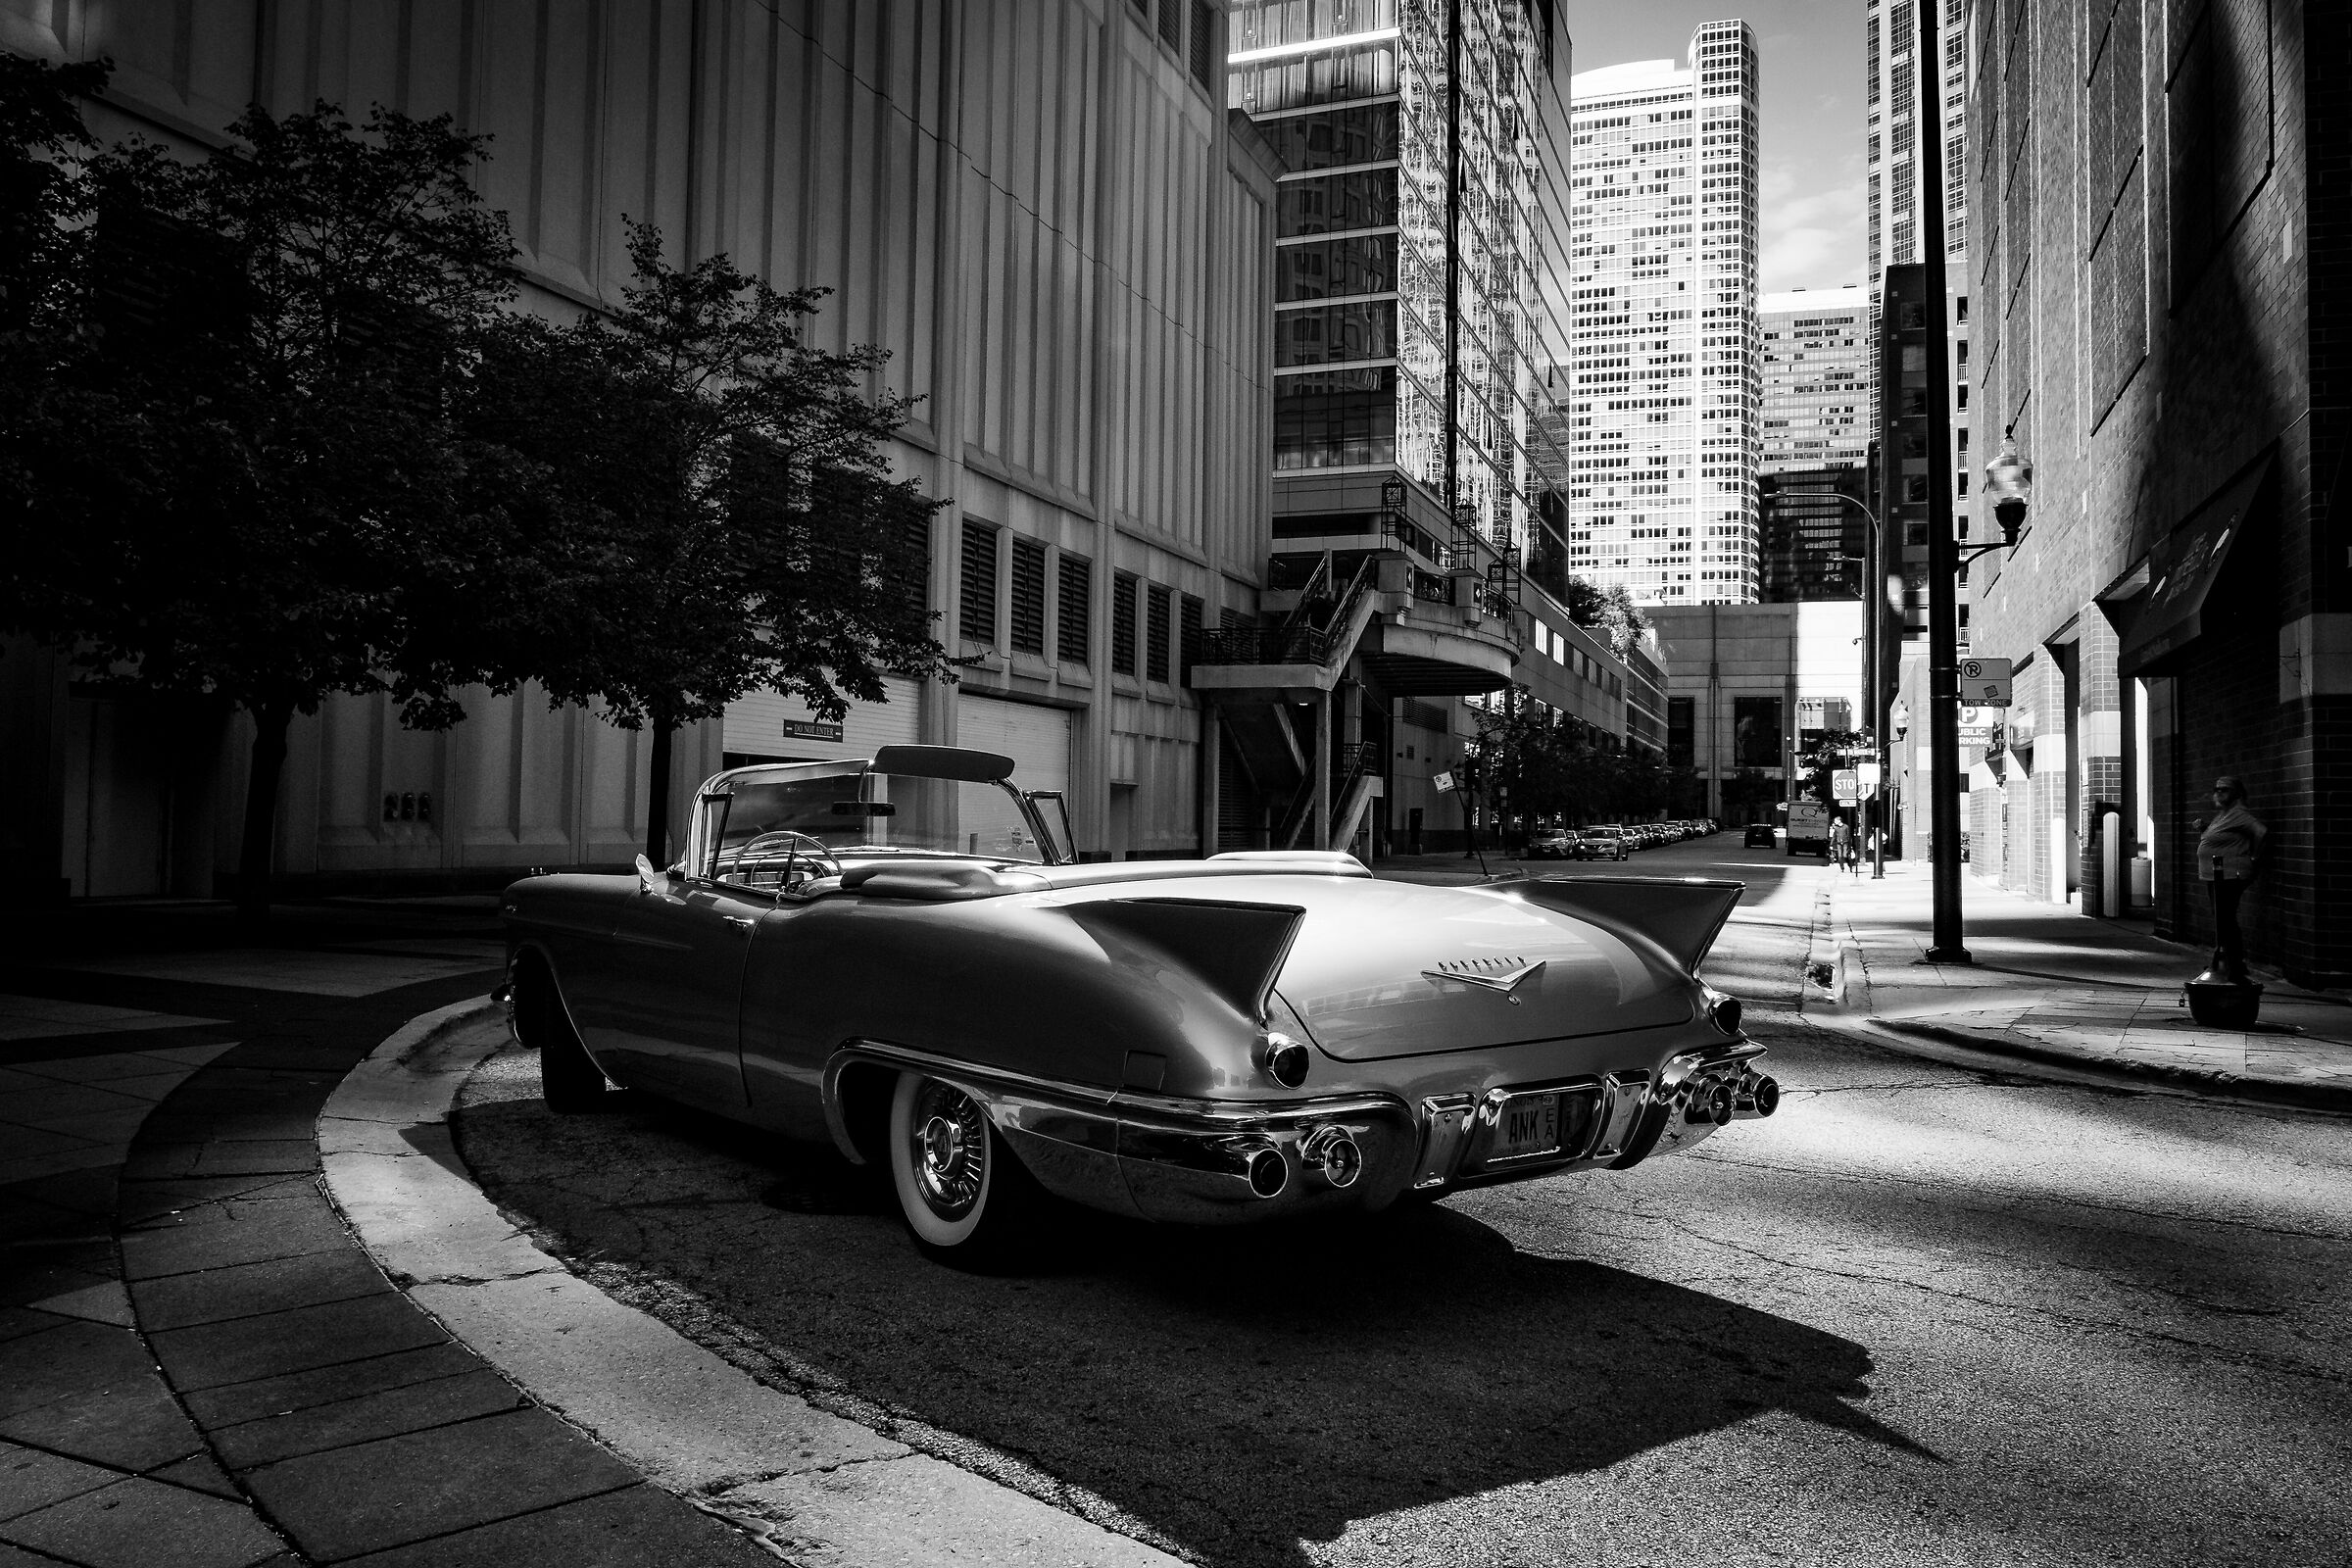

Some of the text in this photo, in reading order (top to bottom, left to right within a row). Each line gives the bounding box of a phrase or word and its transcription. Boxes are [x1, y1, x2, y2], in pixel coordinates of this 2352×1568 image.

[794, 724, 834, 736] DO NOT ENTER
[1959, 736, 1991, 745] RKING
[1835, 778, 1856, 790] STO
[1508, 1109, 1539, 1144] ANK
